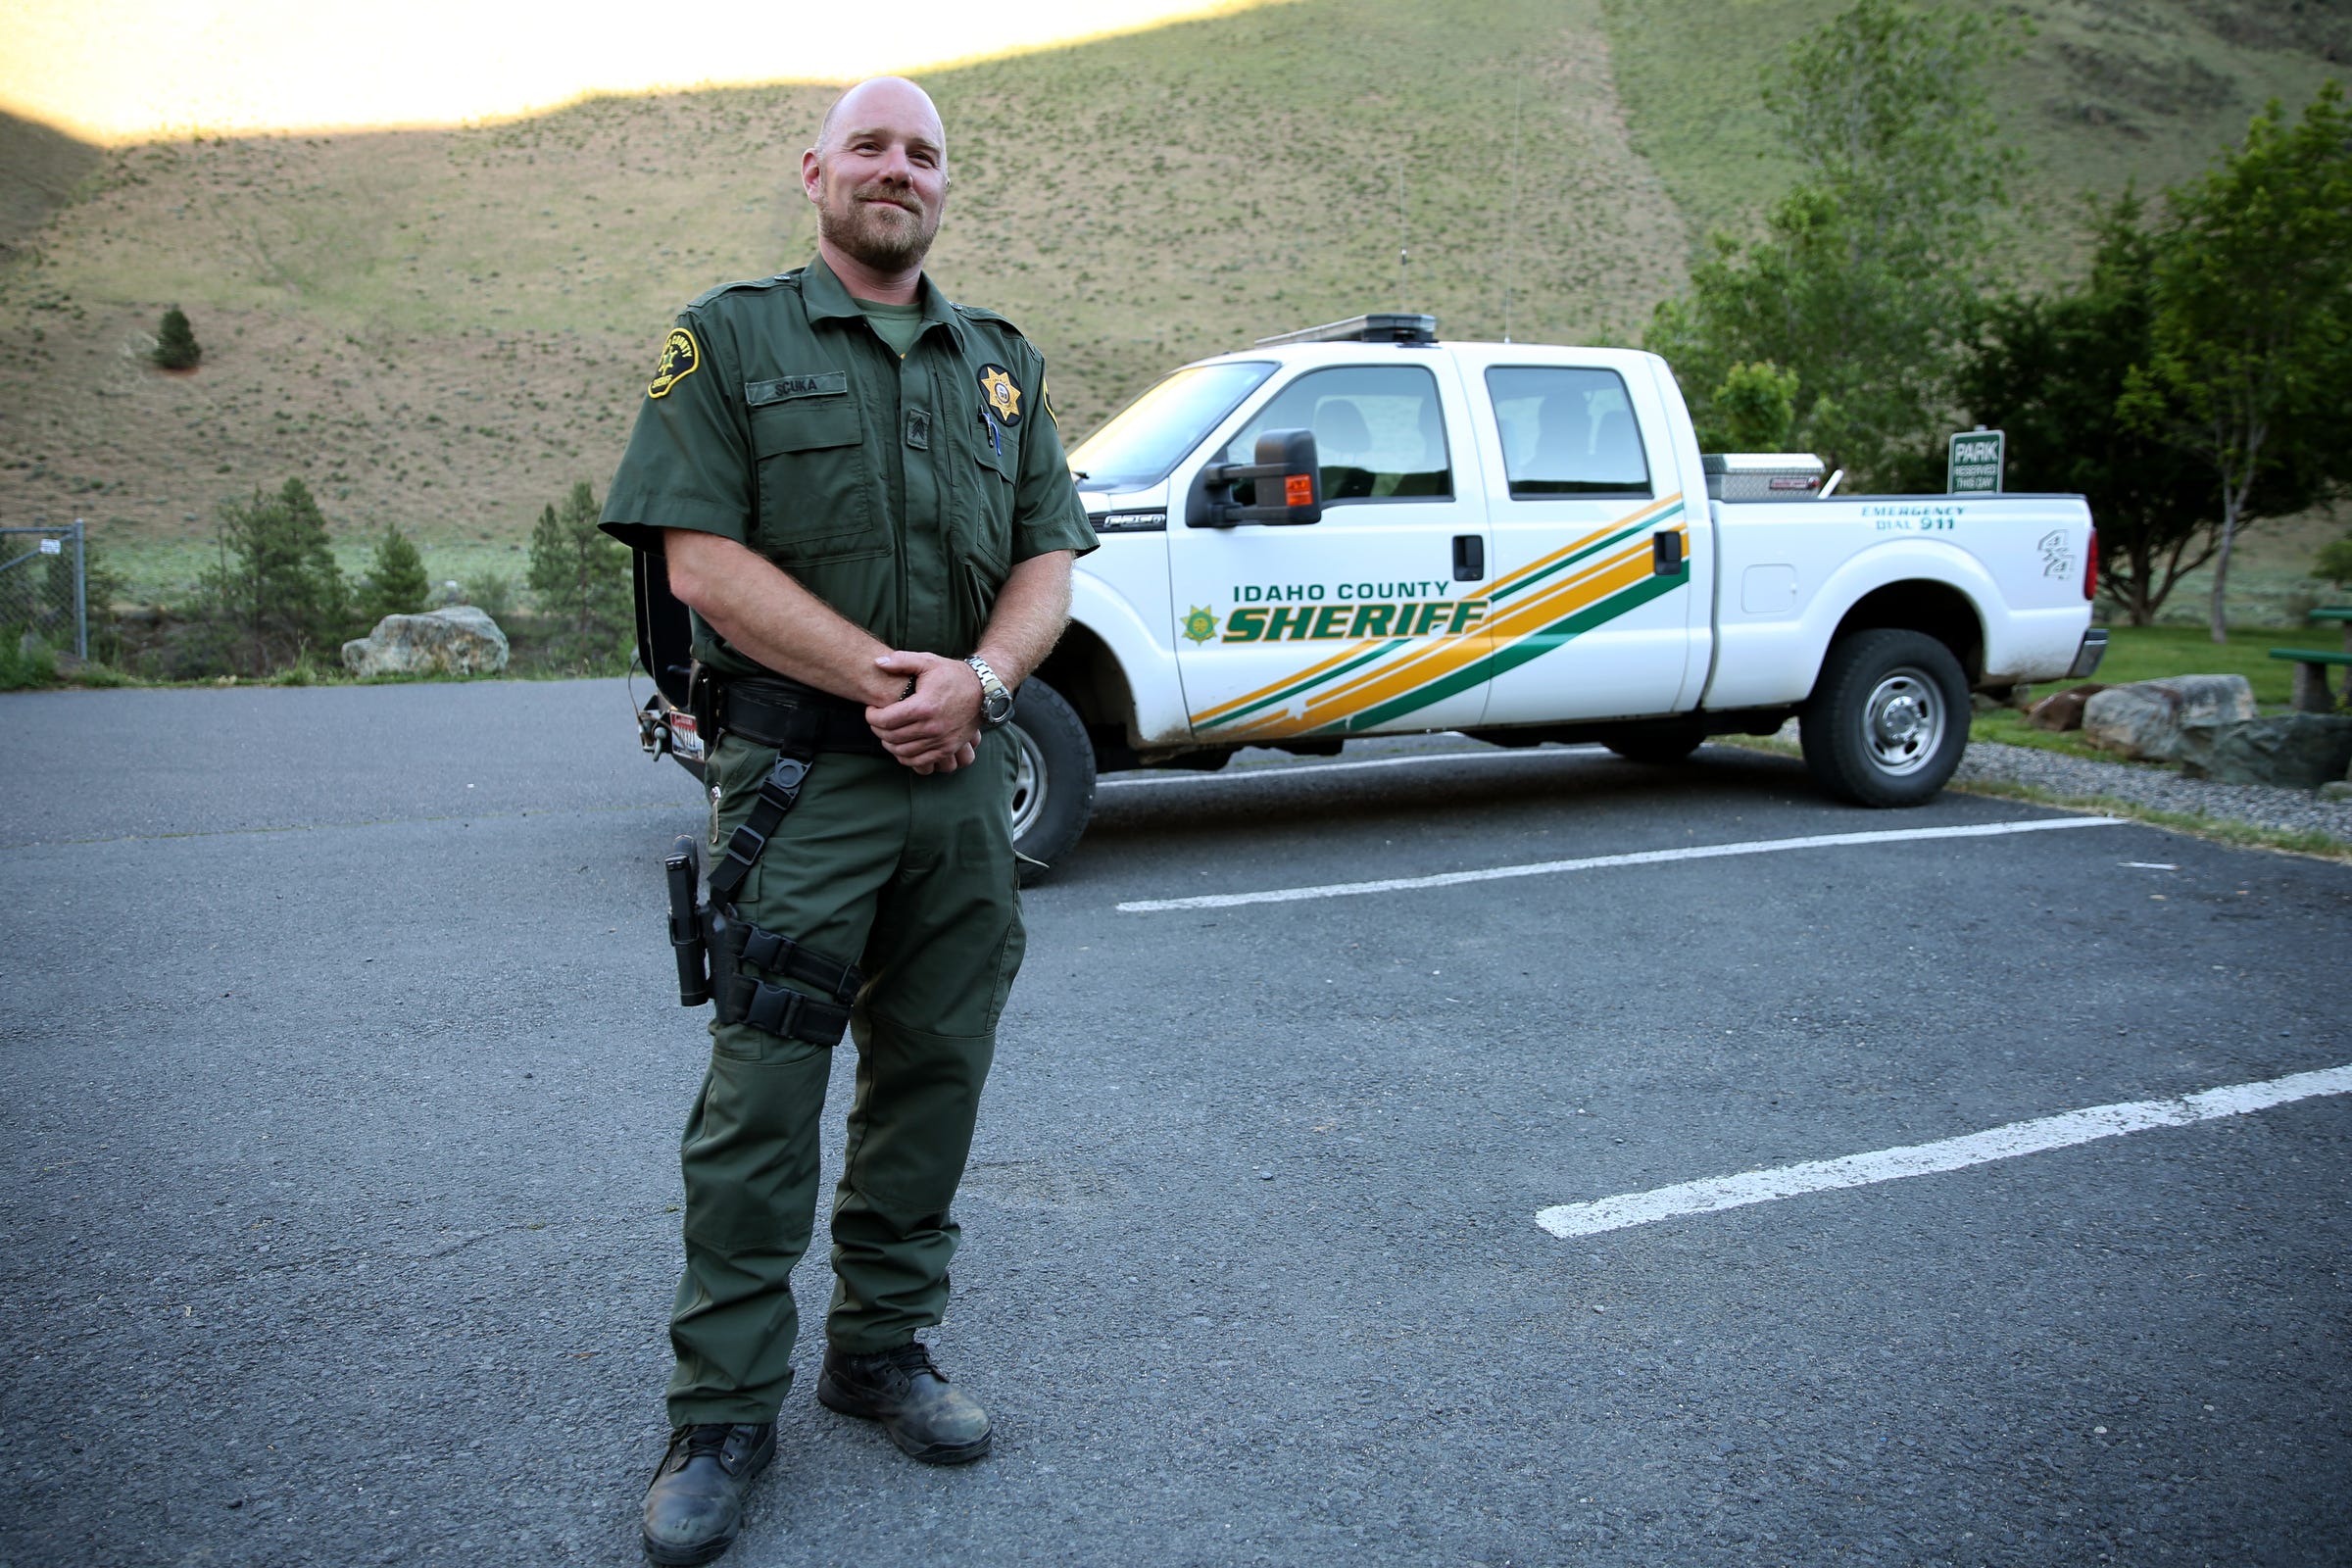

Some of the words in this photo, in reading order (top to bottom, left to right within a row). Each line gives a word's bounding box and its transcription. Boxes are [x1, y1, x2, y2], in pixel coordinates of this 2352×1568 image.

[774, 379, 817, 397] SCUKA
[1955, 441, 1999, 463] PARK
[1862, 507, 1965, 515] EMERGENCY
[1877, 519, 1913, 530] DIAL
[1921, 517, 1955, 530] 911
[1234, 584, 1325, 603] IDAHO
[1337, 580, 1449, 600] COUNTY
[1221, 600, 1489, 644] SHERIFF
